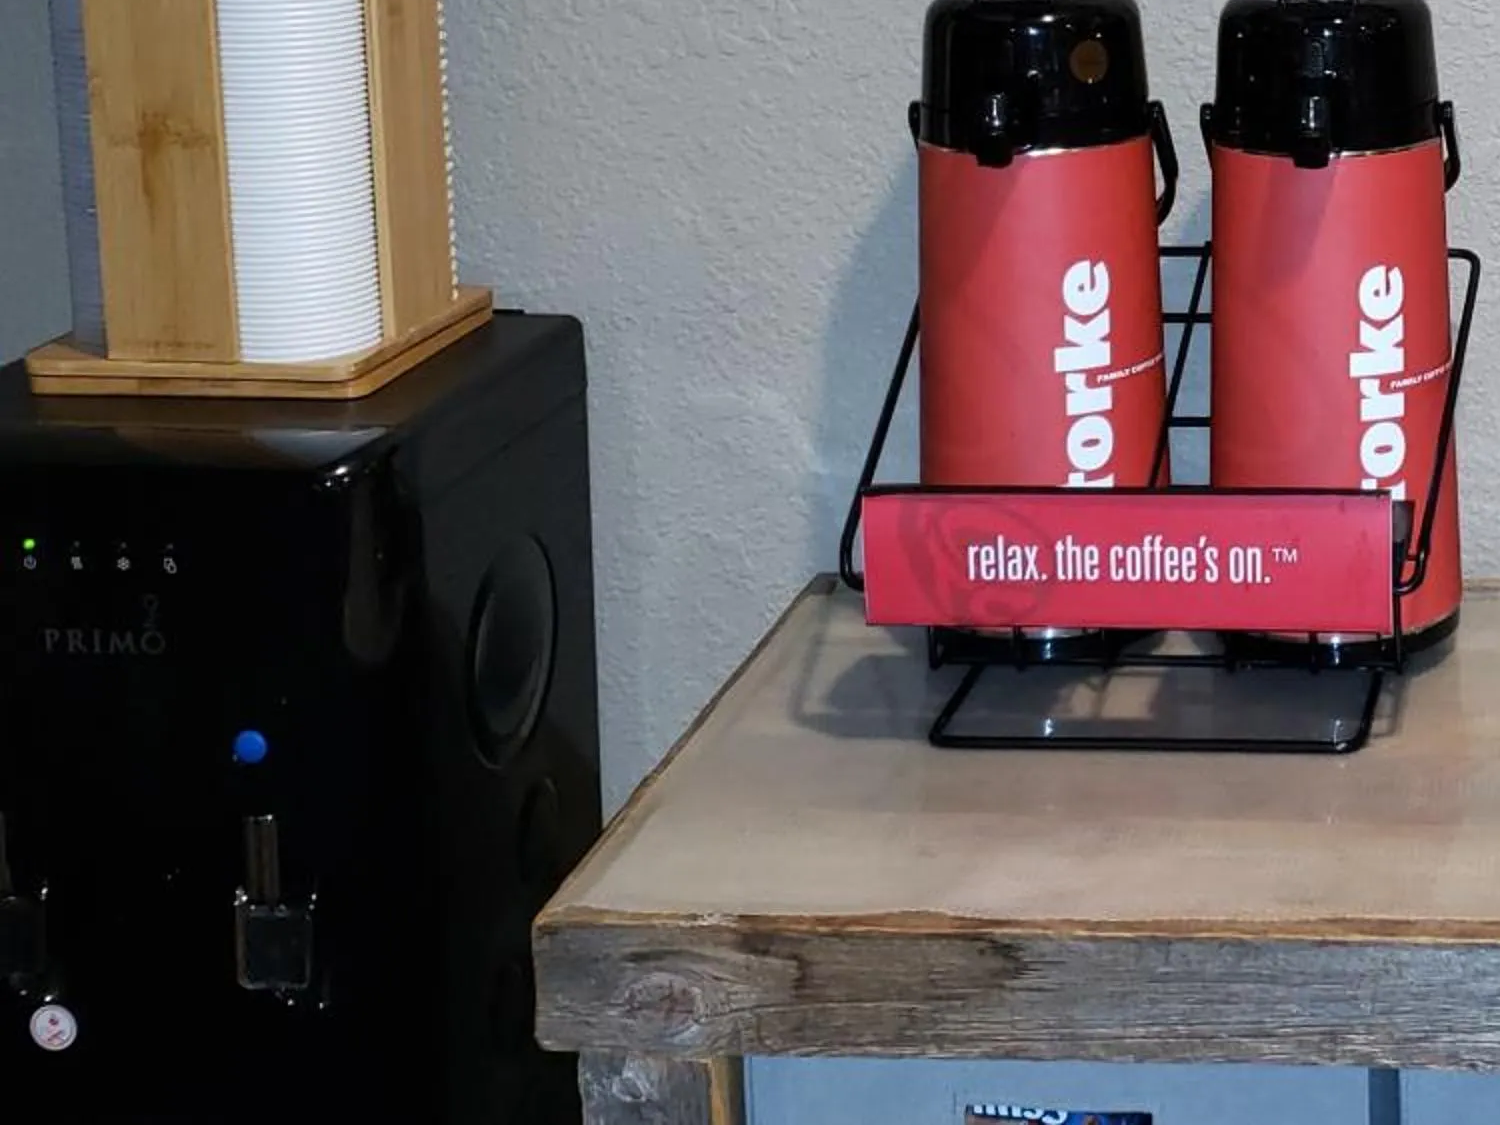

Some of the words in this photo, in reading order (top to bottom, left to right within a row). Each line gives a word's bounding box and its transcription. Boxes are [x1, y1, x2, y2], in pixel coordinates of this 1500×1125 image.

[967, 535, 1048, 582] relax.
[1055, 535, 1100, 581] the
[1109, 535, 1219, 583] coffee's
[43, 627, 167, 655] PRIMO
